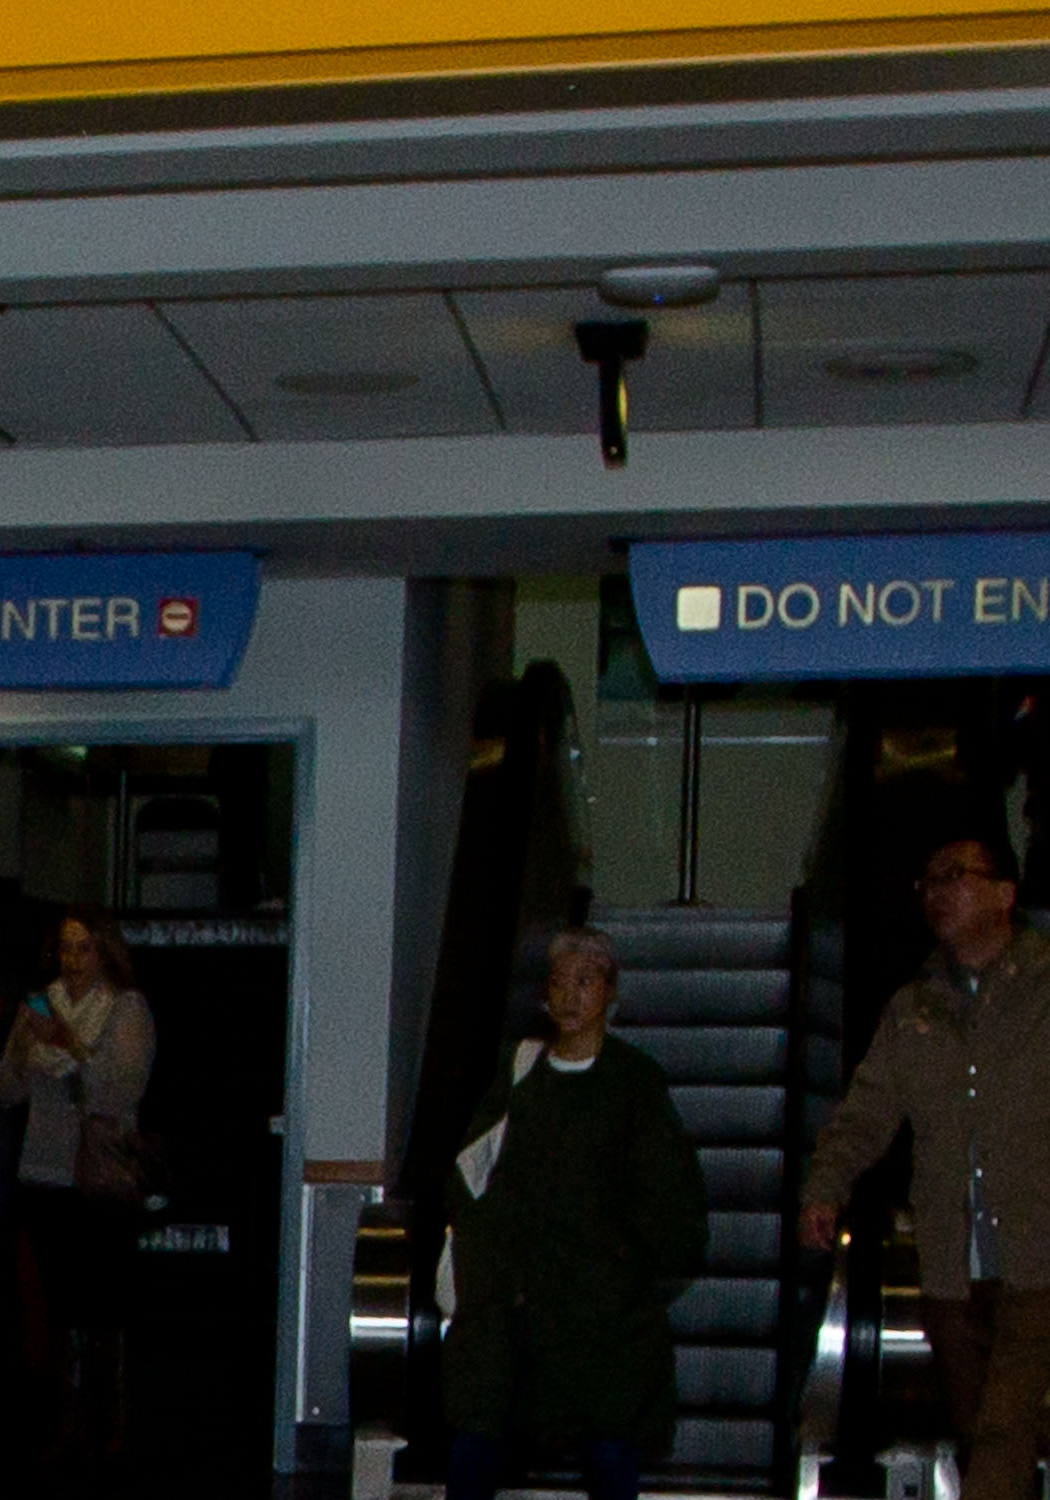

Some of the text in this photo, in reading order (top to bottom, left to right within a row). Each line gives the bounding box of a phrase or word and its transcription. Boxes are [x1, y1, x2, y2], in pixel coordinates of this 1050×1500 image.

[737, 577, 1049, 629] DO NOT EN
